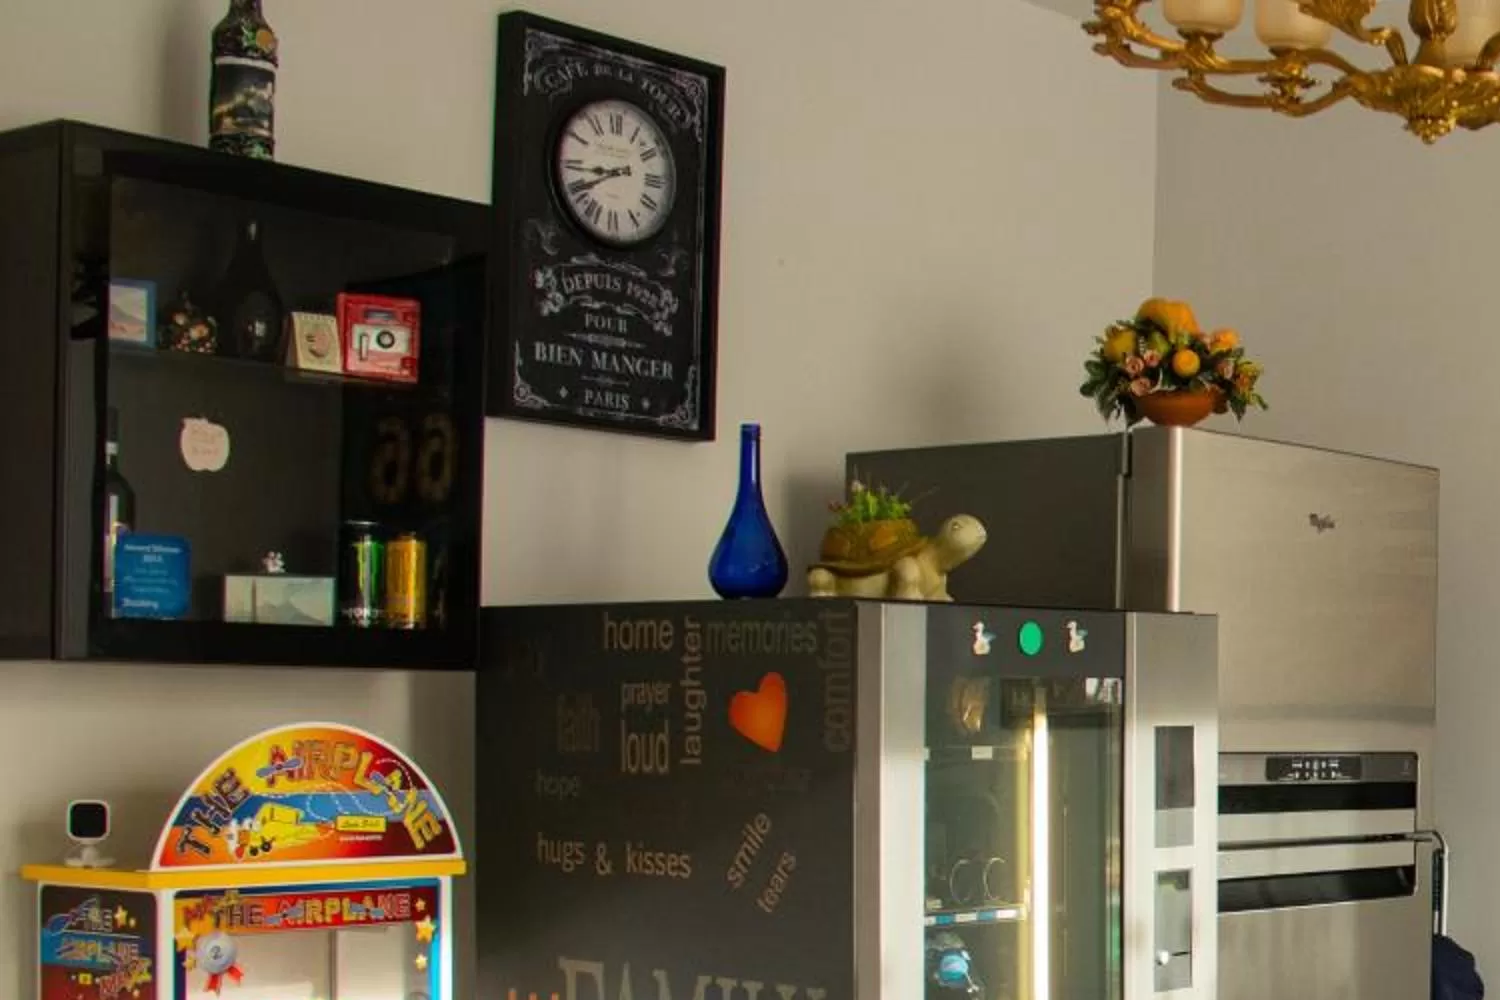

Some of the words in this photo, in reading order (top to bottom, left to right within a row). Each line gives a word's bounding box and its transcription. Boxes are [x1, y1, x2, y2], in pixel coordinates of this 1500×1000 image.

[562, 271, 622, 294] DEPUIS
[584, 312, 627, 334] POUR
[534, 341, 582, 367] BIEN
[591, 349, 674, 381] MANGER
[584, 387, 631, 411] PARIS
[603, 612, 675, 651] home
[705, 612, 818, 653] memories
[621, 680, 672, 713] prayer
[680, 615, 706, 765] laughter
[818, 608, 850, 753] comfort
[621, 718, 670, 775] loud
[176, 767, 251, 856] THE
[256, 740, 442, 851] AIRPLANE
[535, 769, 582, 800] hope
[537, 832, 585, 873] hugs
[594, 842, 612, 876] &
[626, 841, 692, 879] kisses
[727, 812, 773, 889] smile
[757, 851, 797, 914] tears
[213, 903, 265, 929] THE
[270, 893, 411, 926] AIRPLANE
